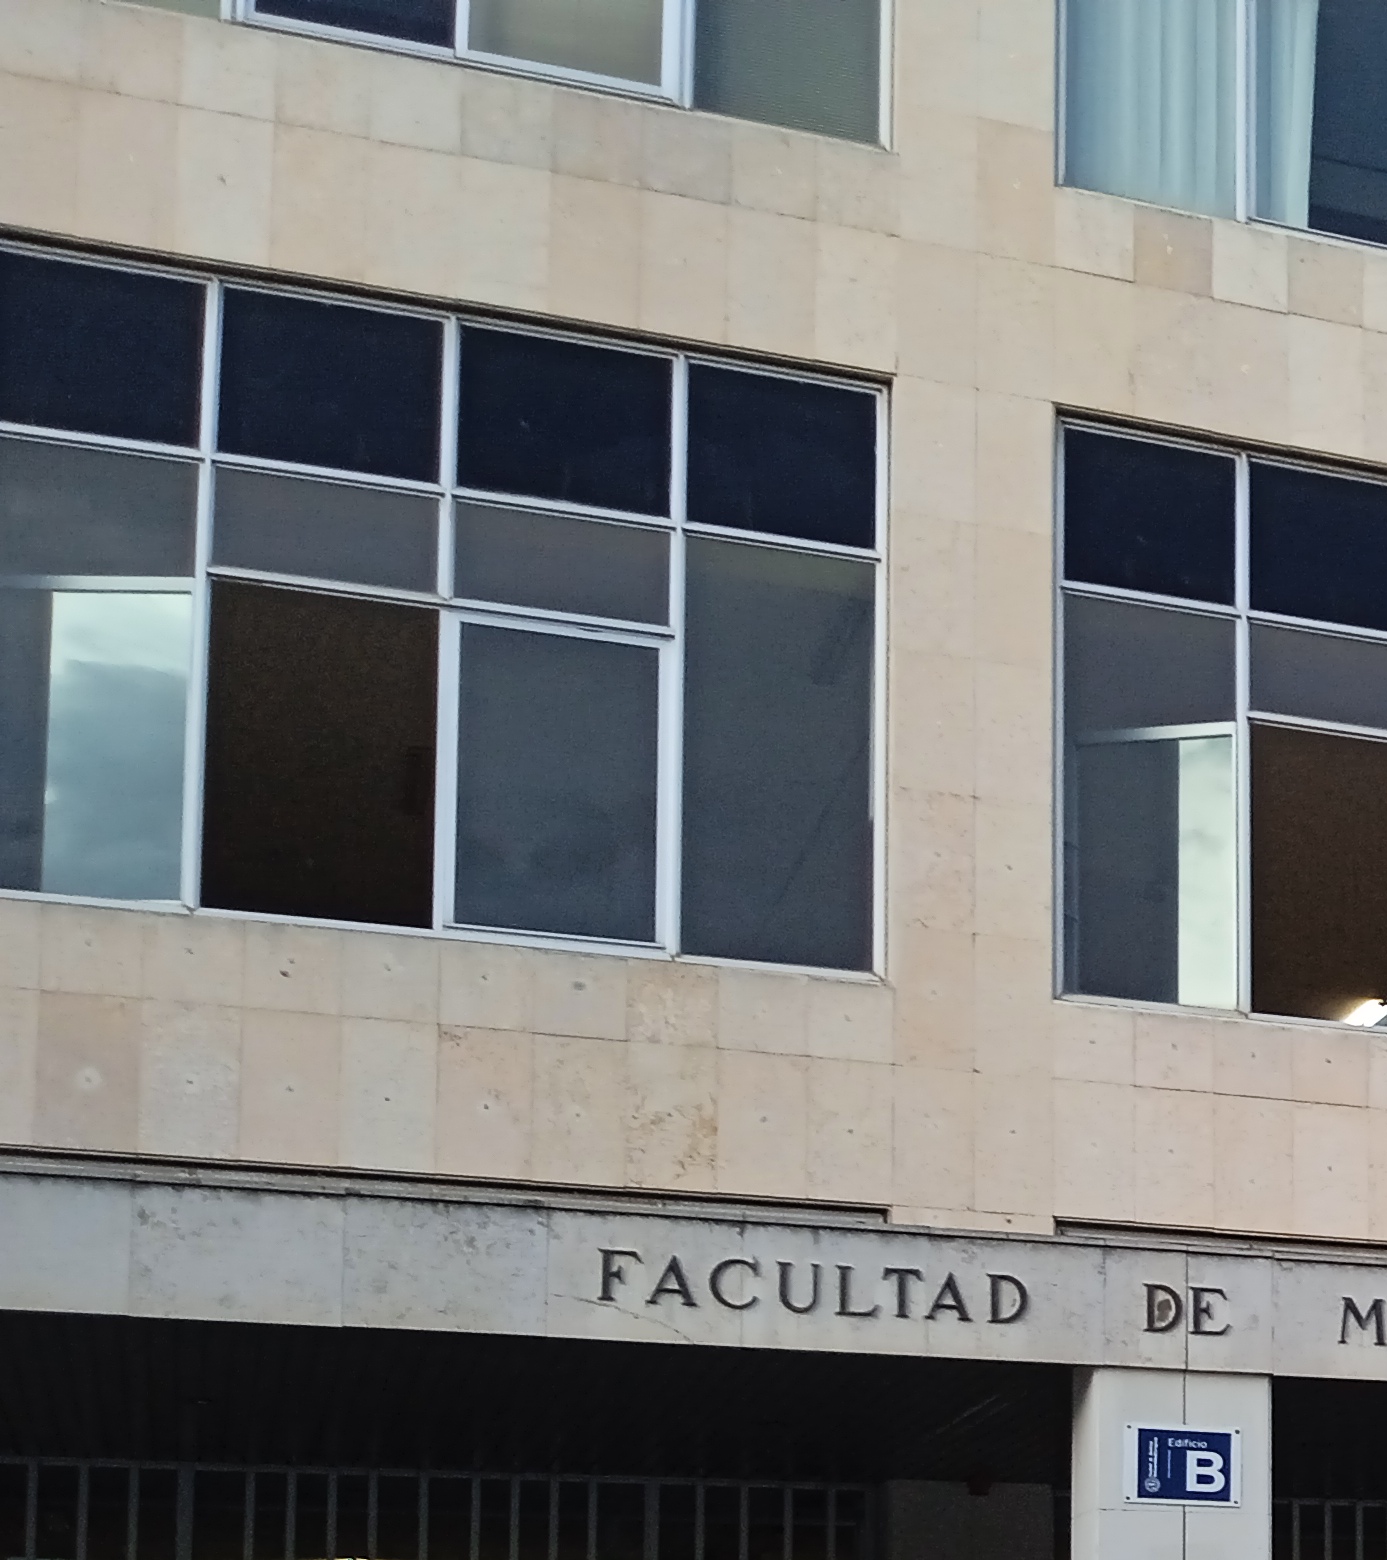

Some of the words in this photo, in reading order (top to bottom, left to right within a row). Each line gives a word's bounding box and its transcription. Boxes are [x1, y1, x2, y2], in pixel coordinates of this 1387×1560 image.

[597, 1247, 1030, 1324] FACULTAD
[1143, 1282, 1231, 1337] DE
[1167, 1437, 1208, 1449] Edificio
[1186, 1450, 1226, 1493] B
